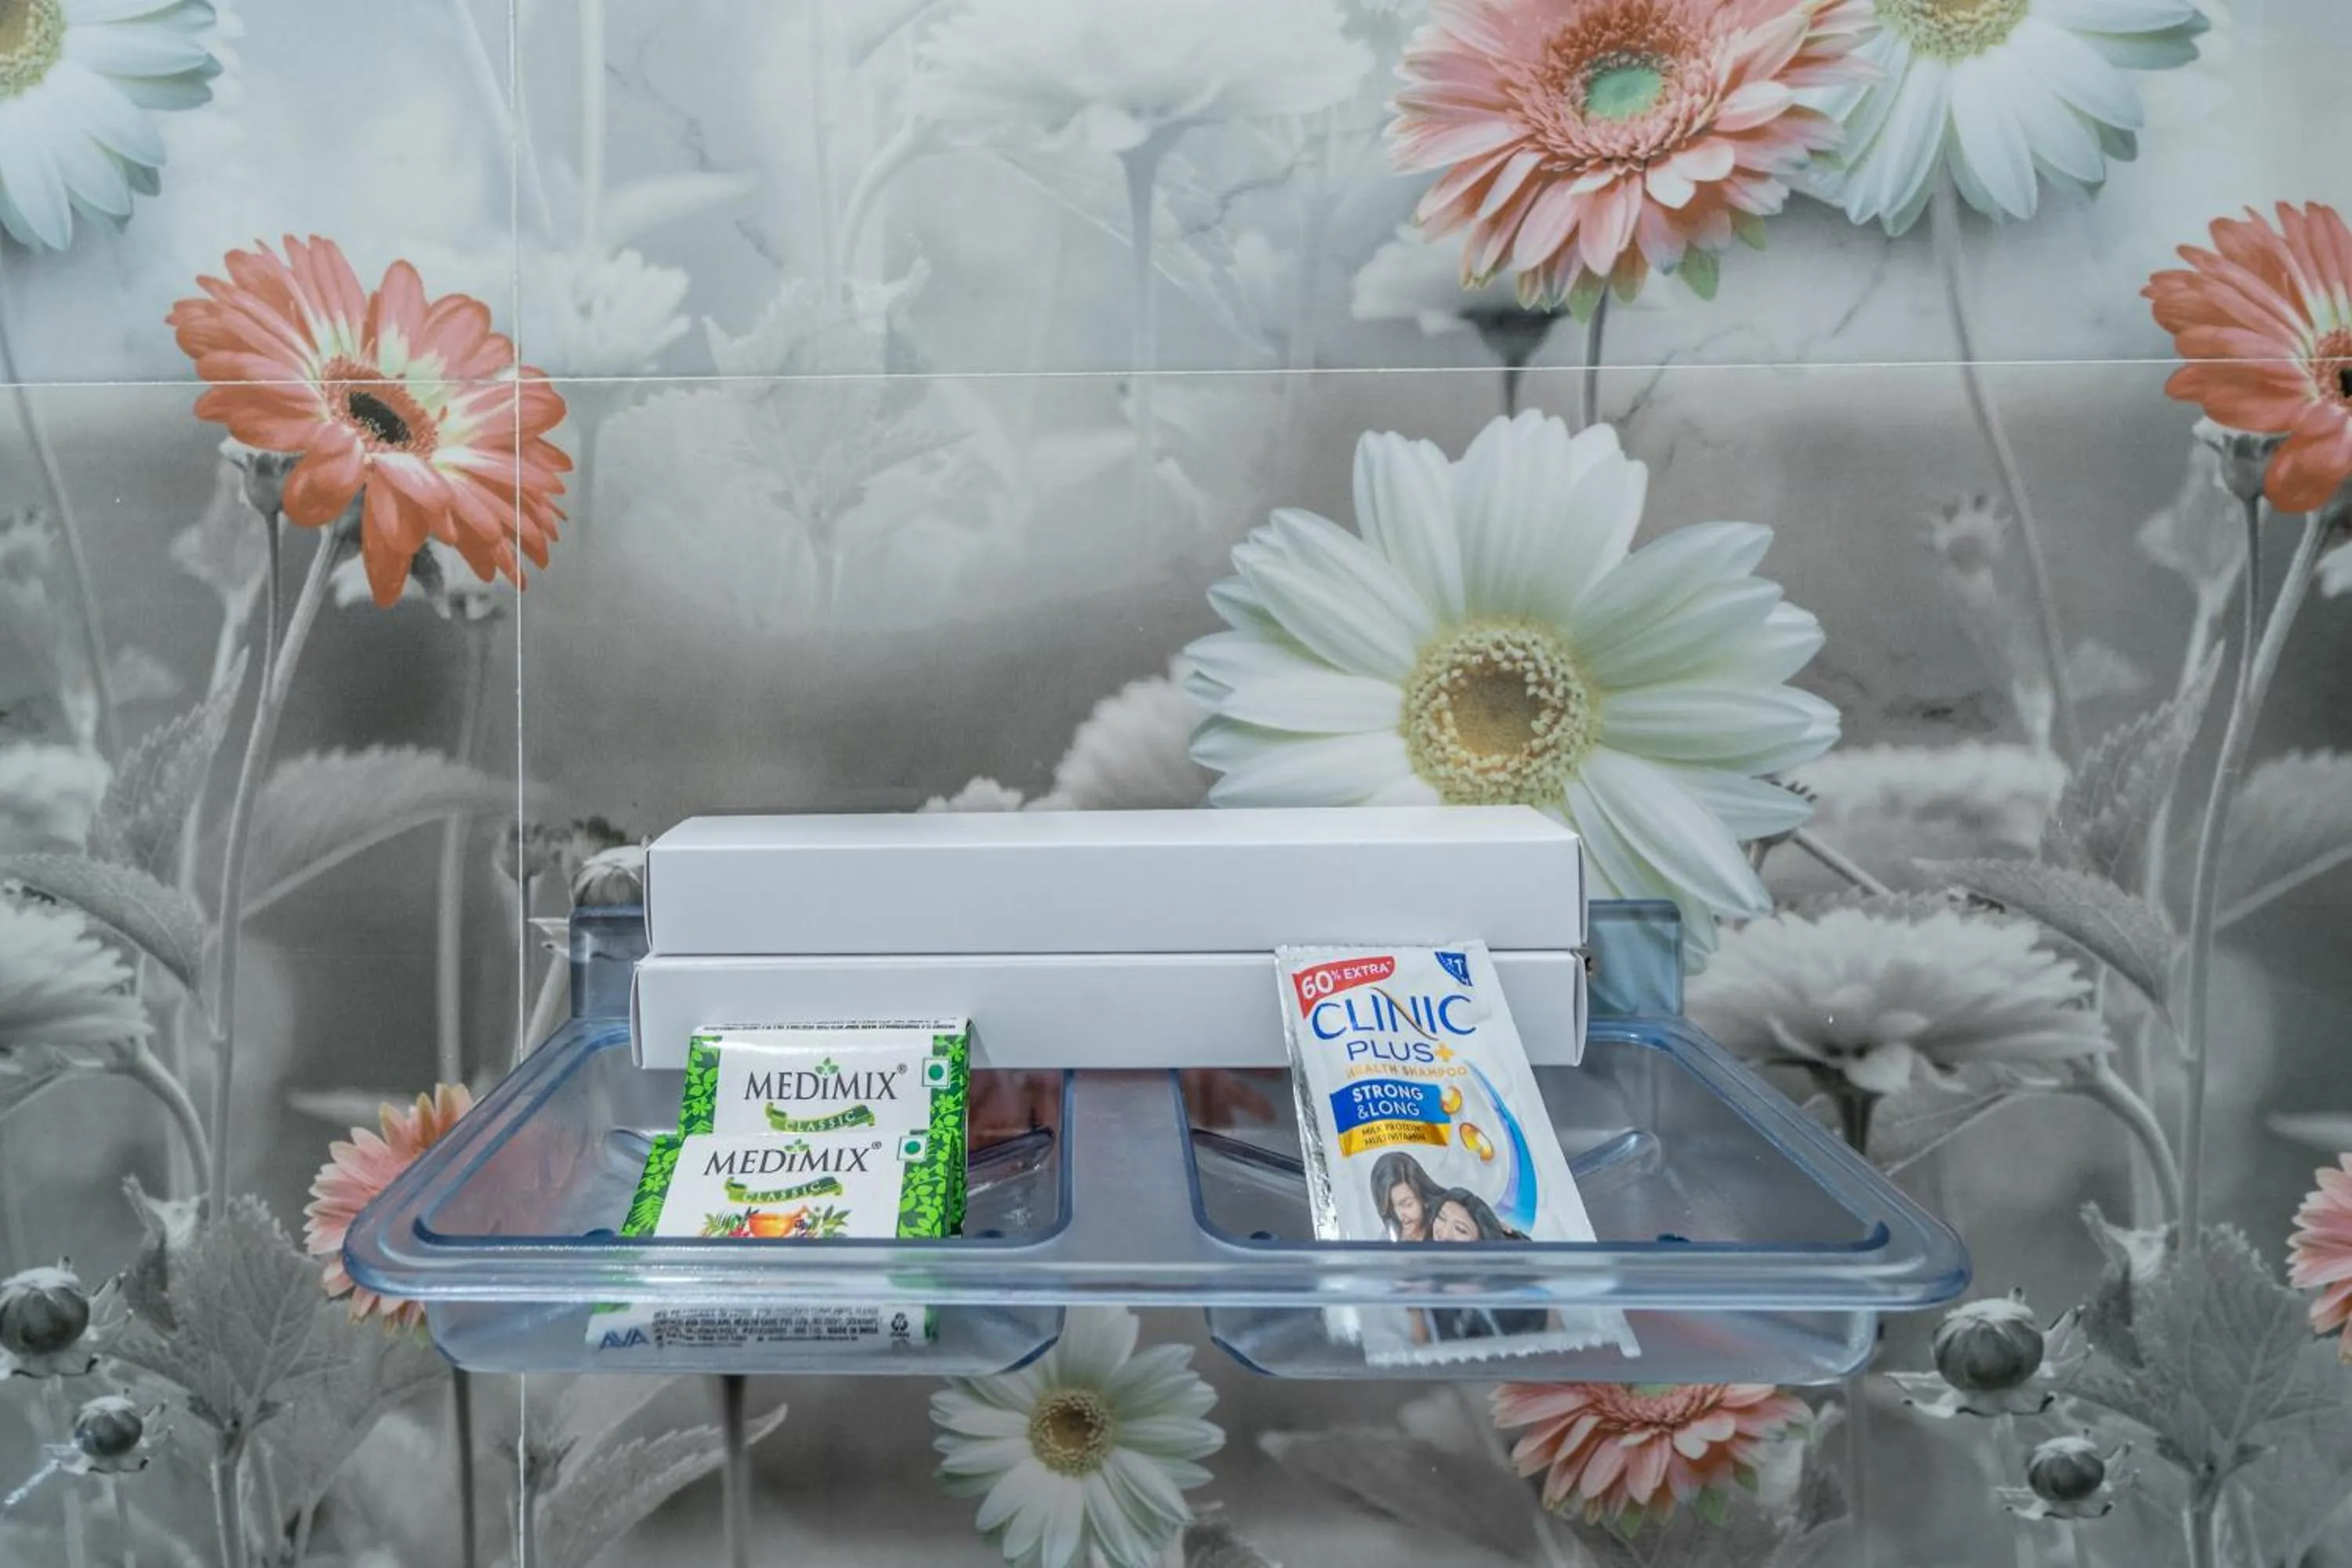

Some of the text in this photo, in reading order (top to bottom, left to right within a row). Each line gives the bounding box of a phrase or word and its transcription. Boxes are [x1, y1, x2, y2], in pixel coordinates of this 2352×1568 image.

[1312, 993, 1477, 1040] CLINIC
[1402, 1065, 1468, 1079] SHAMPOO
[1352, 1083, 1424, 1103] STRONG
[1357, 1100, 1421, 1120] &LONG
[785, 1110, 857, 1132] CLASSIC
[743, 1181, 822, 1203] CLASSIC
